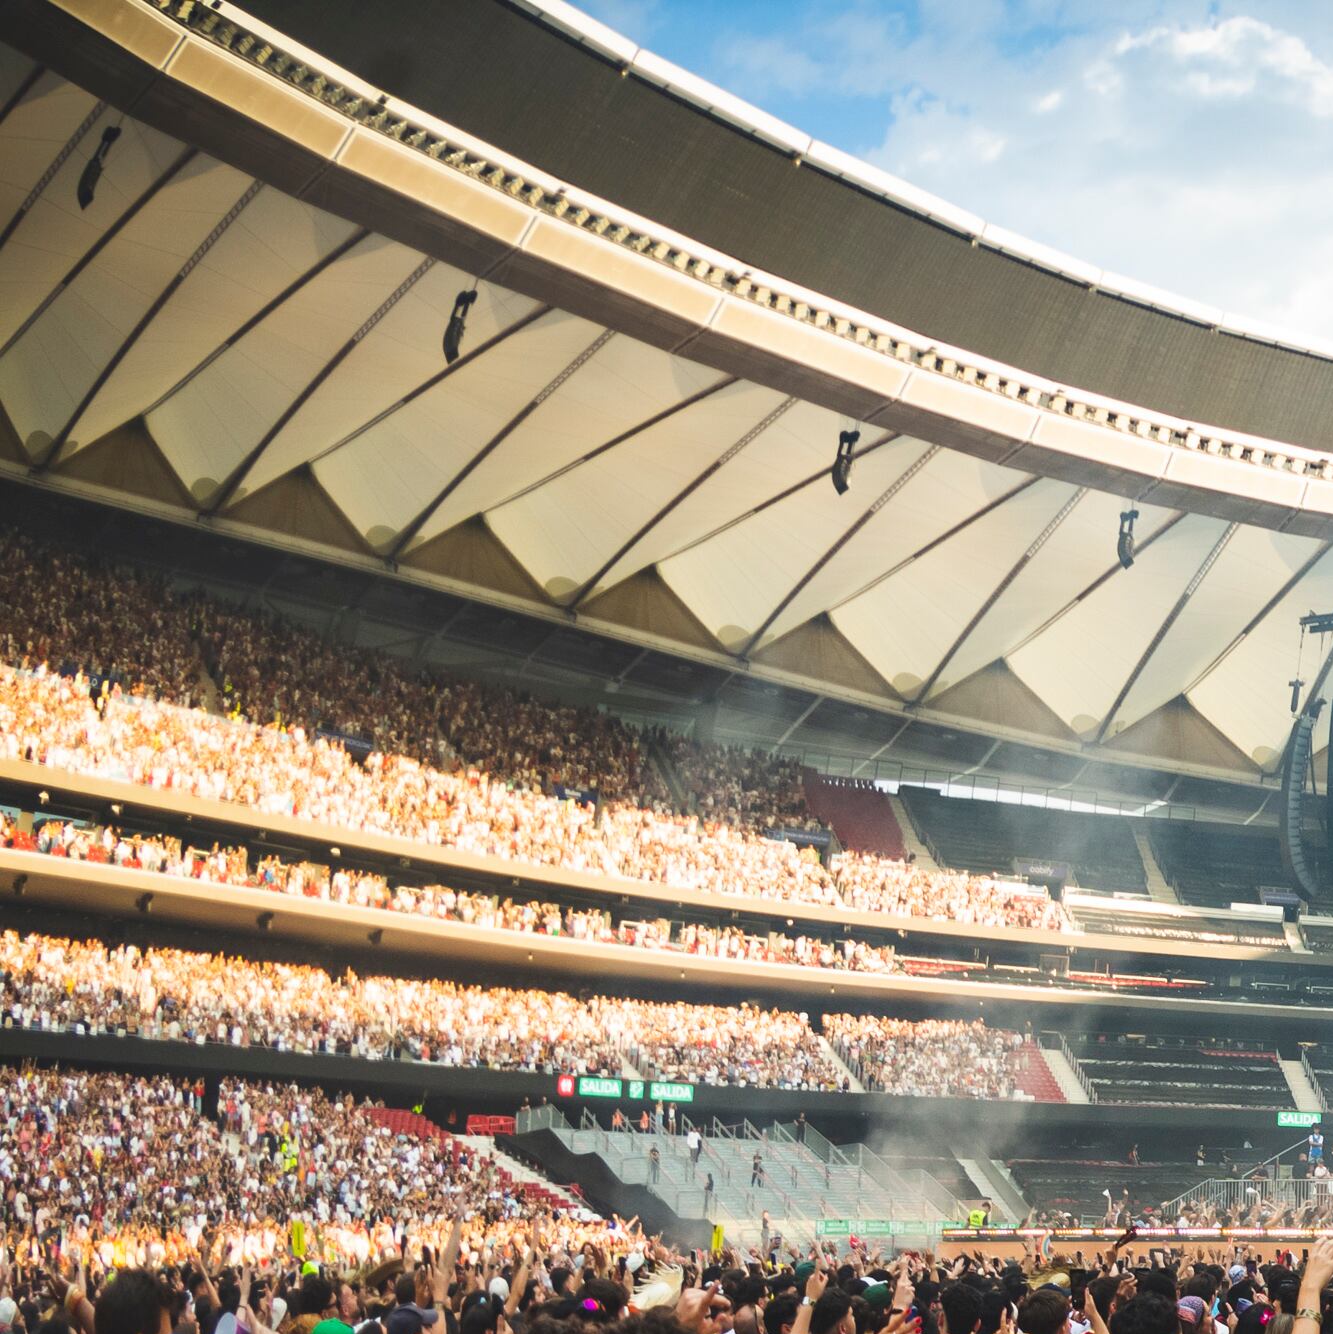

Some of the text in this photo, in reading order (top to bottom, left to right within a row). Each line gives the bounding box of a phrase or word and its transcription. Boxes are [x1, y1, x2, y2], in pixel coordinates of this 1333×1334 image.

[581, 1079, 621, 1095] SALIDA
[652, 1082, 692, 1099] SALIDA
[1280, 1113, 1320, 1125] SALIDA
